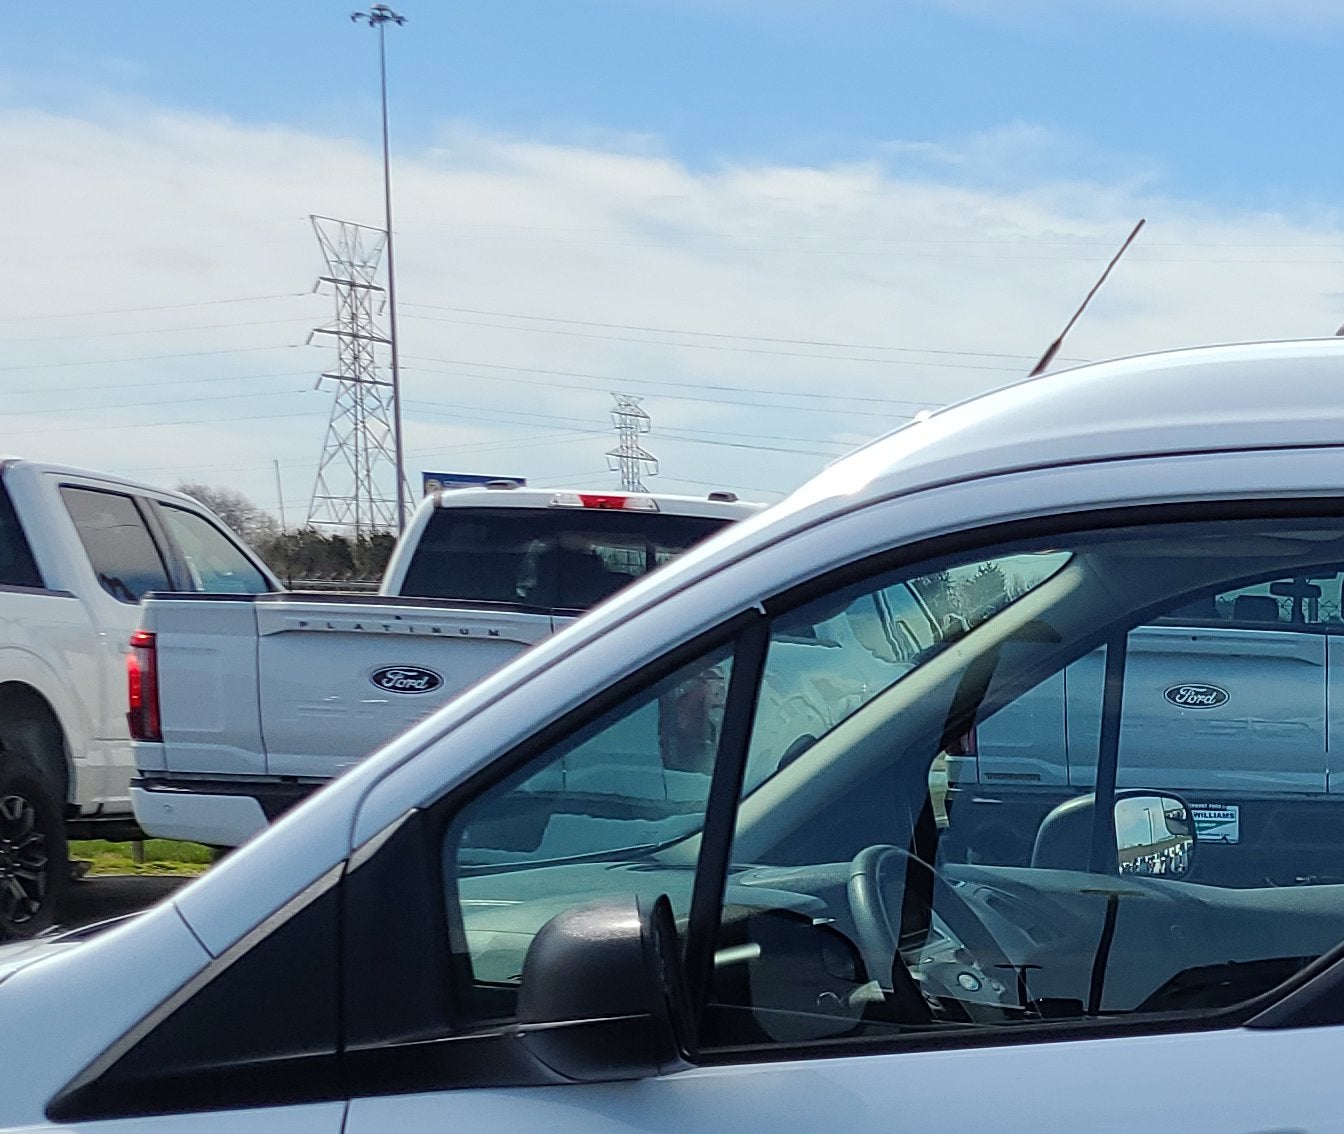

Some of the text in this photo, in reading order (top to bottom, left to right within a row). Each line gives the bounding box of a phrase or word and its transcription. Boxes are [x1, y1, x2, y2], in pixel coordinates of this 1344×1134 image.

[299, 620, 500, 637] PLATINUM
[380, 670, 430, 689] Ford
[1175, 686, 1218, 704] Ford
[1193, 811, 1235, 819] WILLIAMS
